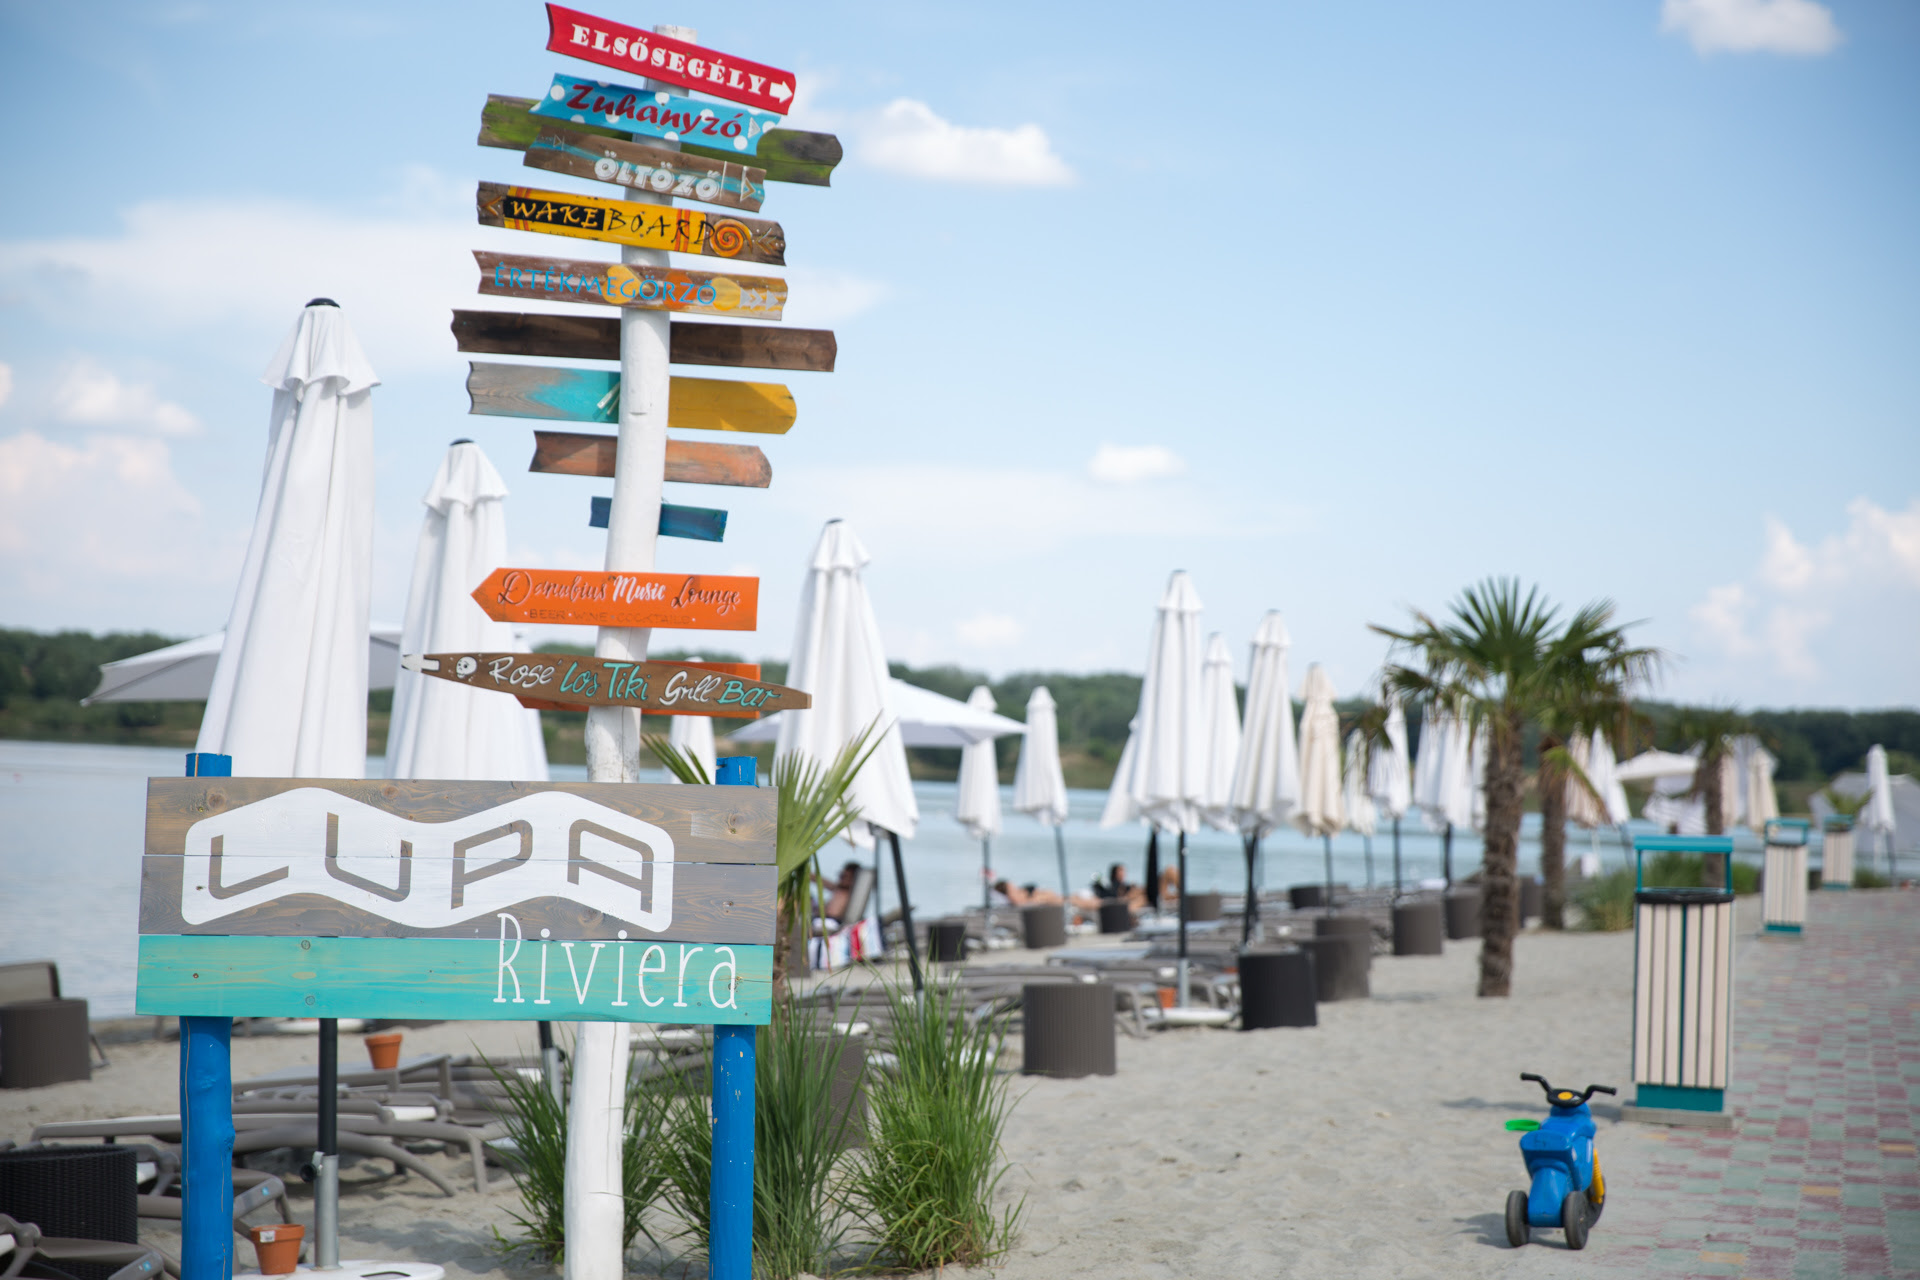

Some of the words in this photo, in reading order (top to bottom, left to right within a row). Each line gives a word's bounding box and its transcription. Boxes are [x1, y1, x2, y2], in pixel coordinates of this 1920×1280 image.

[570, 23, 767, 96] ELSŐSEGÉLY
[566, 84, 743, 139] Zuhanyzó
[594, 150, 721, 201] ÖLTÖZŐ
[497, 571, 607, 606] Danubius
[611, 575, 666, 604] Music
[671, 576, 741, 616] Lounge
[529, 608, 566, 620] BEER
[559, 661, 600, 697] Los
[602, 662, 651, 701] Tiki
[659, 670, 721, 706] Grill
[716, 680, 782, 708] Bar
[208, 811, 654, 914] LUPA
[493, 912, 739, 1010] Riviera
